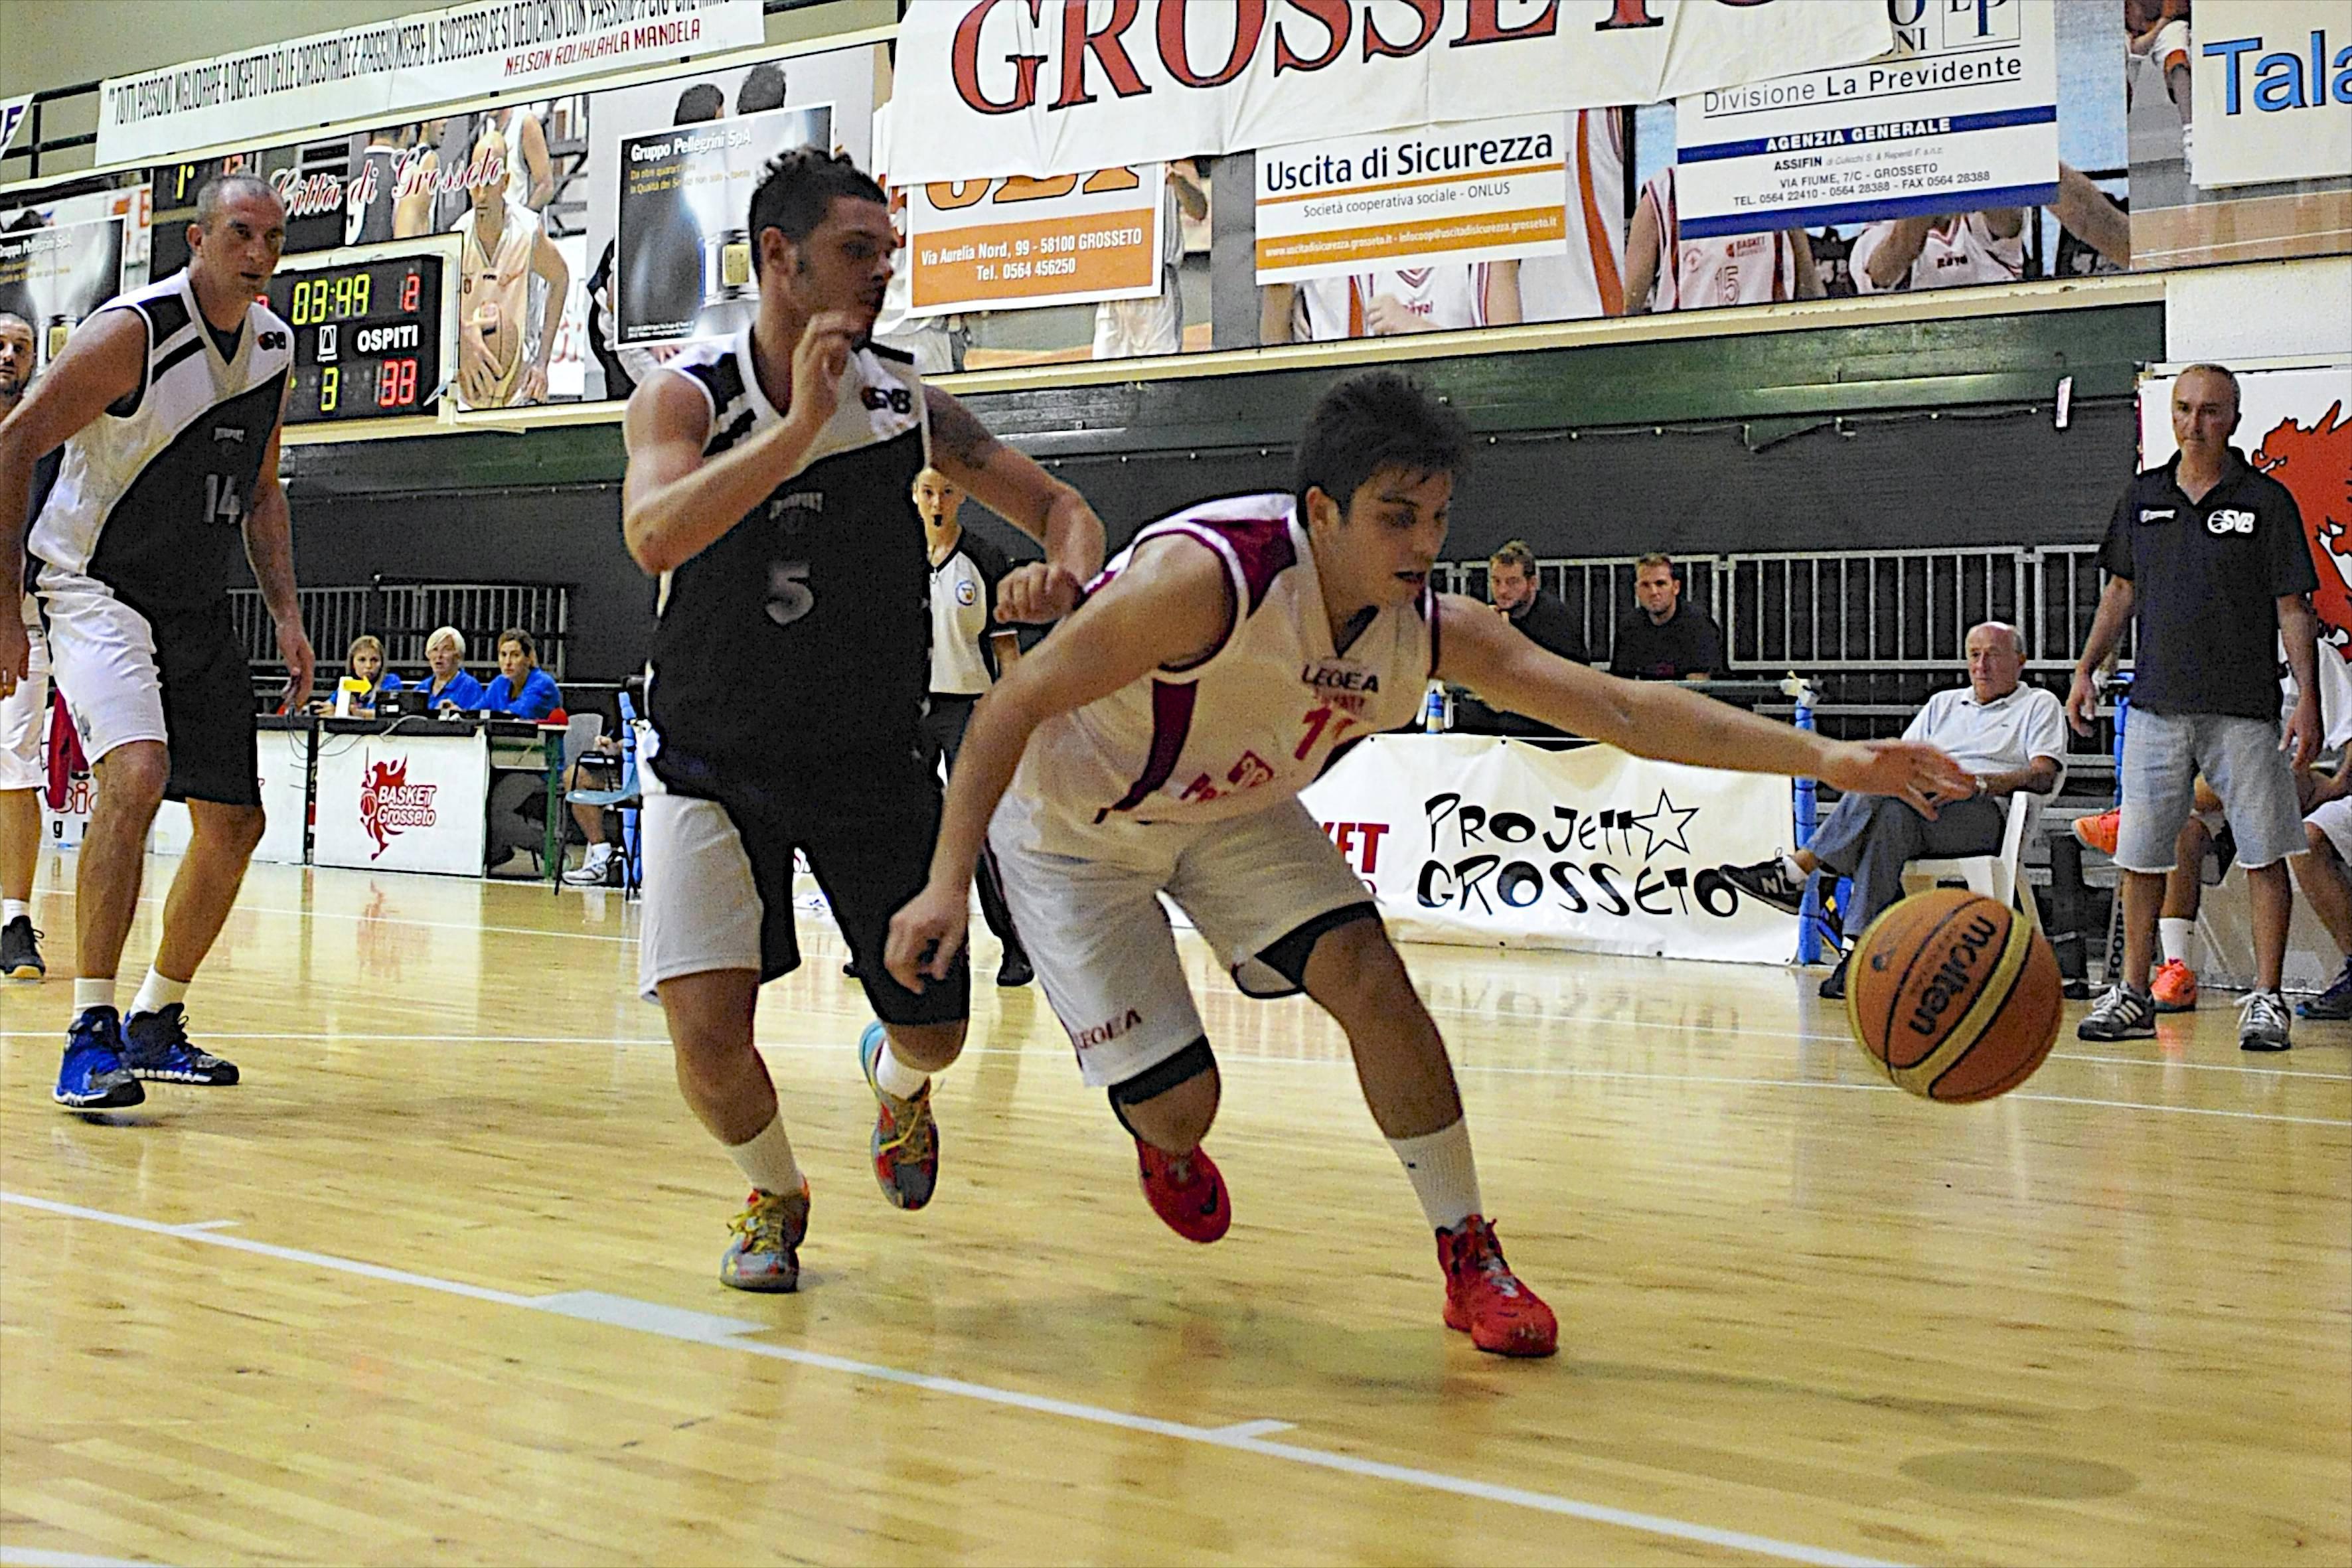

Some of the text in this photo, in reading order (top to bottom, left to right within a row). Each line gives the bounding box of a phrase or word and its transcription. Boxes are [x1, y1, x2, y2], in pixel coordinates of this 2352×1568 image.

[439, 11, 487, 62] SUCCESSO
[505, 48, 554, 76] NELSON
[635, 19, 700, 50] MANDELA
[1703, 56, 2022, 112] Divisione La Previdente
[631, 143, 671, 162] Gruppo
[673, 130, 726, 155] Pellegrini
[1765, 130, 1845, 152] AGENZIA
[1851, 118, 1952, 141] GENERALE
[390, 146, 505, 198] Grosseto
[1267, 133, 1553, 191] Uscita di Sicurezza
[1774, 156, 1823, 171] ASSIFIN
[1780, 178, 1798, 189] VIA
[1802, 173, 1840, 186] FIUME,
[1843, 171, 1862, 181] 7/C
[1874, 163, 1938, 178] GROSSETO
[1303, 203, 1343, 218] Società
[1346, 194, 1413, 213] cooperativa
[1417, 187, 1456, 204] sociale
[1467, 181, 1510, 198] ONLUS
[1733, 196, 1756, 206] TEL.
[1759, 193, 1784, 204] 0564
[1788, 189, 1818, 200] 22410
[1830, 185, 1855, 196] 0564
[1858, 182, 1890, 194] 28388
[1902, 179, 1923, 190] FAX
[1927, 175, 1953, 187] 0564
[1957, 171, 1990, 183] 28388
[921, 250, 937, 266] Via
[939, 246, 975, 265] Aurelia
[978, 242, 1012, 260] Nord,
[1015, 240, 1030, 255] 99
[1040, 235, 1075, 254] 58100
[1078, 227, 1142, 251] GROSSETO
[976, 257, 1076, 281] Tel. 0564 456250
[292, 274, 370, 325] 03:49
[356, 324, 419, 353] OSPITI
[320, 367, 339, 412] 3
[203, 473, 240, 524] 14
[765, 564, 815, 626] 5
[377, 805, 436, 826] Grosseto
[378, 785, 437, 807] BASKET
[1417, 854, 1739, 917] GROSSETO
[1909, 915, 1997, 1036] molten
